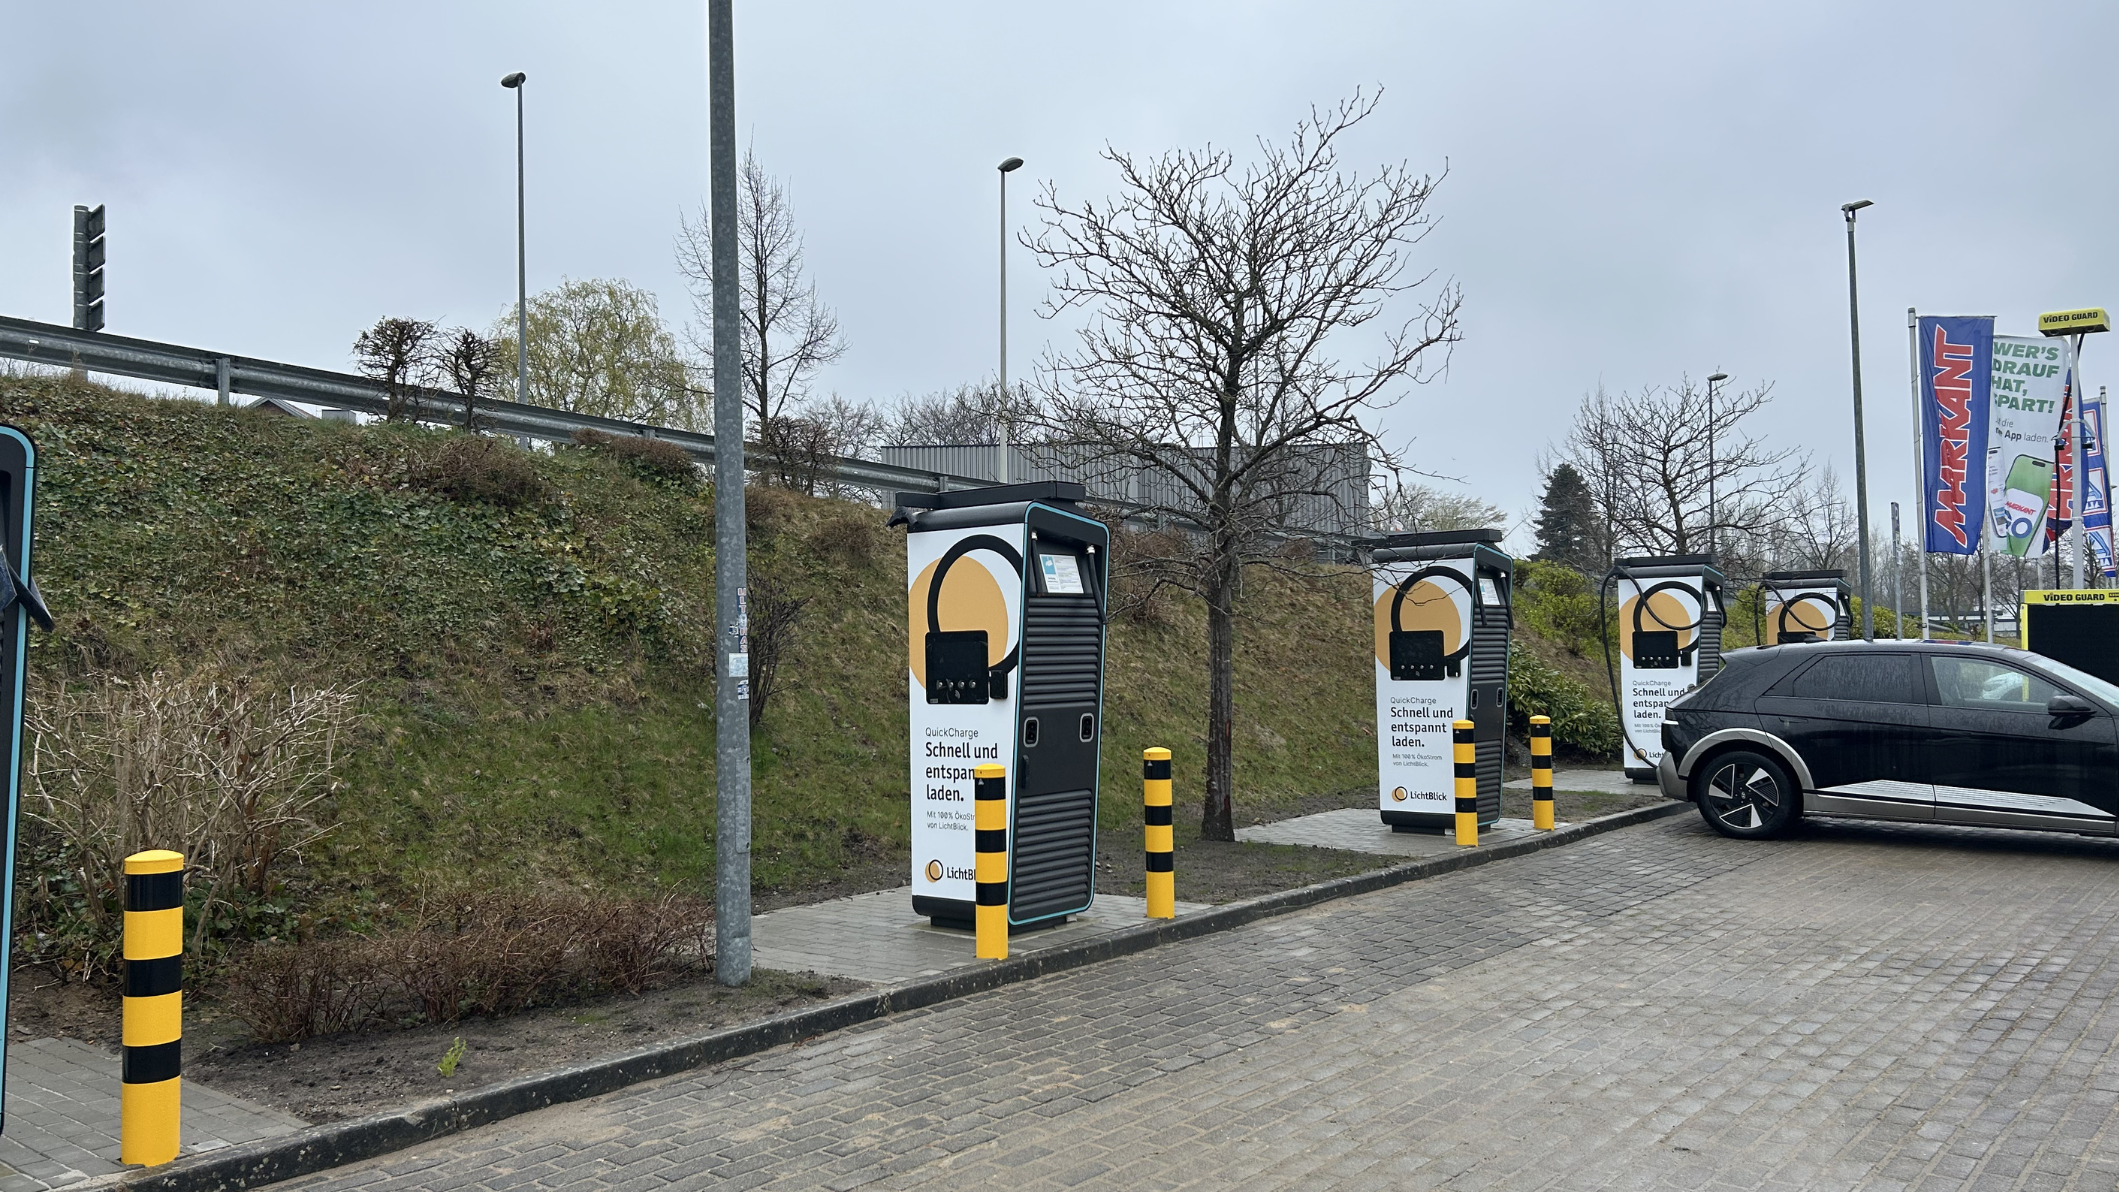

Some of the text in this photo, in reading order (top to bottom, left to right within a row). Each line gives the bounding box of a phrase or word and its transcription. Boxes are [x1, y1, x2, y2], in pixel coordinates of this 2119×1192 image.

[2071, 311, 2098, 321] GUARD
[1993, 341, 2060, 361] WER'S
[1992, 358, 2060, 378] DRAUF
[1992, 375, 2028, 397] HAT,
[1933, 323, 1974, 549] MARKANT
[2004, 430, 2022, 441] App
[2023, 432, 2049, 443] laden.
[2075, 592, 2105, 601] GUARD
[1632, 688, 1666, 697] Schnell
[1390, 697, 1437, 705] QuickCharge
[1390, 706, 1453, 718] Schnell und
[1633, 710, 1662, 719] laden.
[925, 727, 979, 740] QuickCharge
[1391, 722, 1447, 735] entspannt
[1392, 735, 1425, 748] laden.
[925, 742, 998, 759] Schnell und
[926, 765, 976, 784] entspan
[926, 784, 964, 802] laden.
[1410, 791, 1448, 801] LichtBlick
[946, 867, 976, 881] LichtBl
